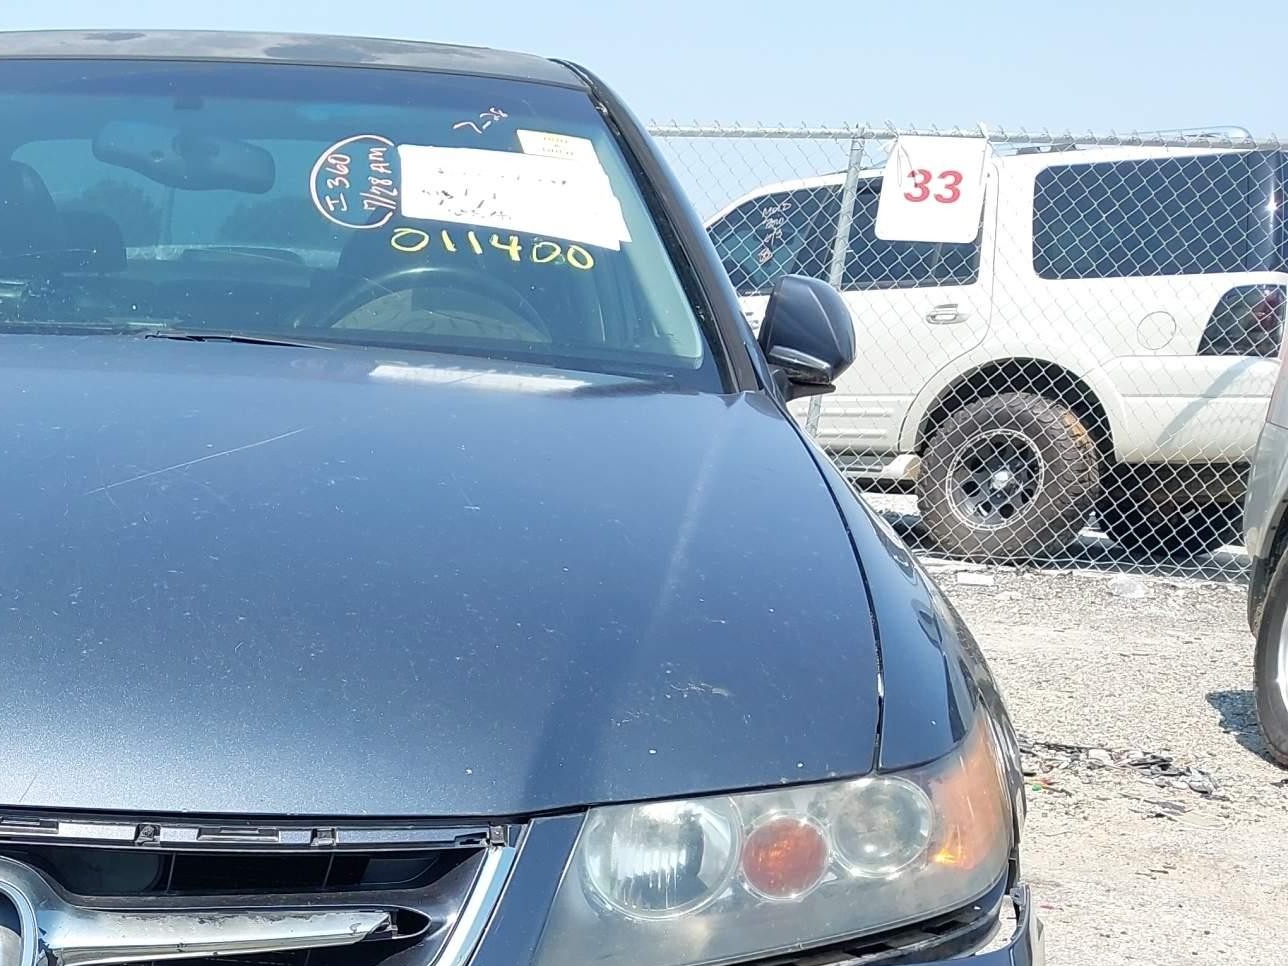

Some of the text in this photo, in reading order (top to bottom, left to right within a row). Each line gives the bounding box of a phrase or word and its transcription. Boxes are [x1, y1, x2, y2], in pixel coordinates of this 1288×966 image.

[325, 153, 352, 189] 360
[359, 147, 399, 211] 7/28 AM
[903, 168, 964, 204] 33
[391, 227, 595, 270] 011400
